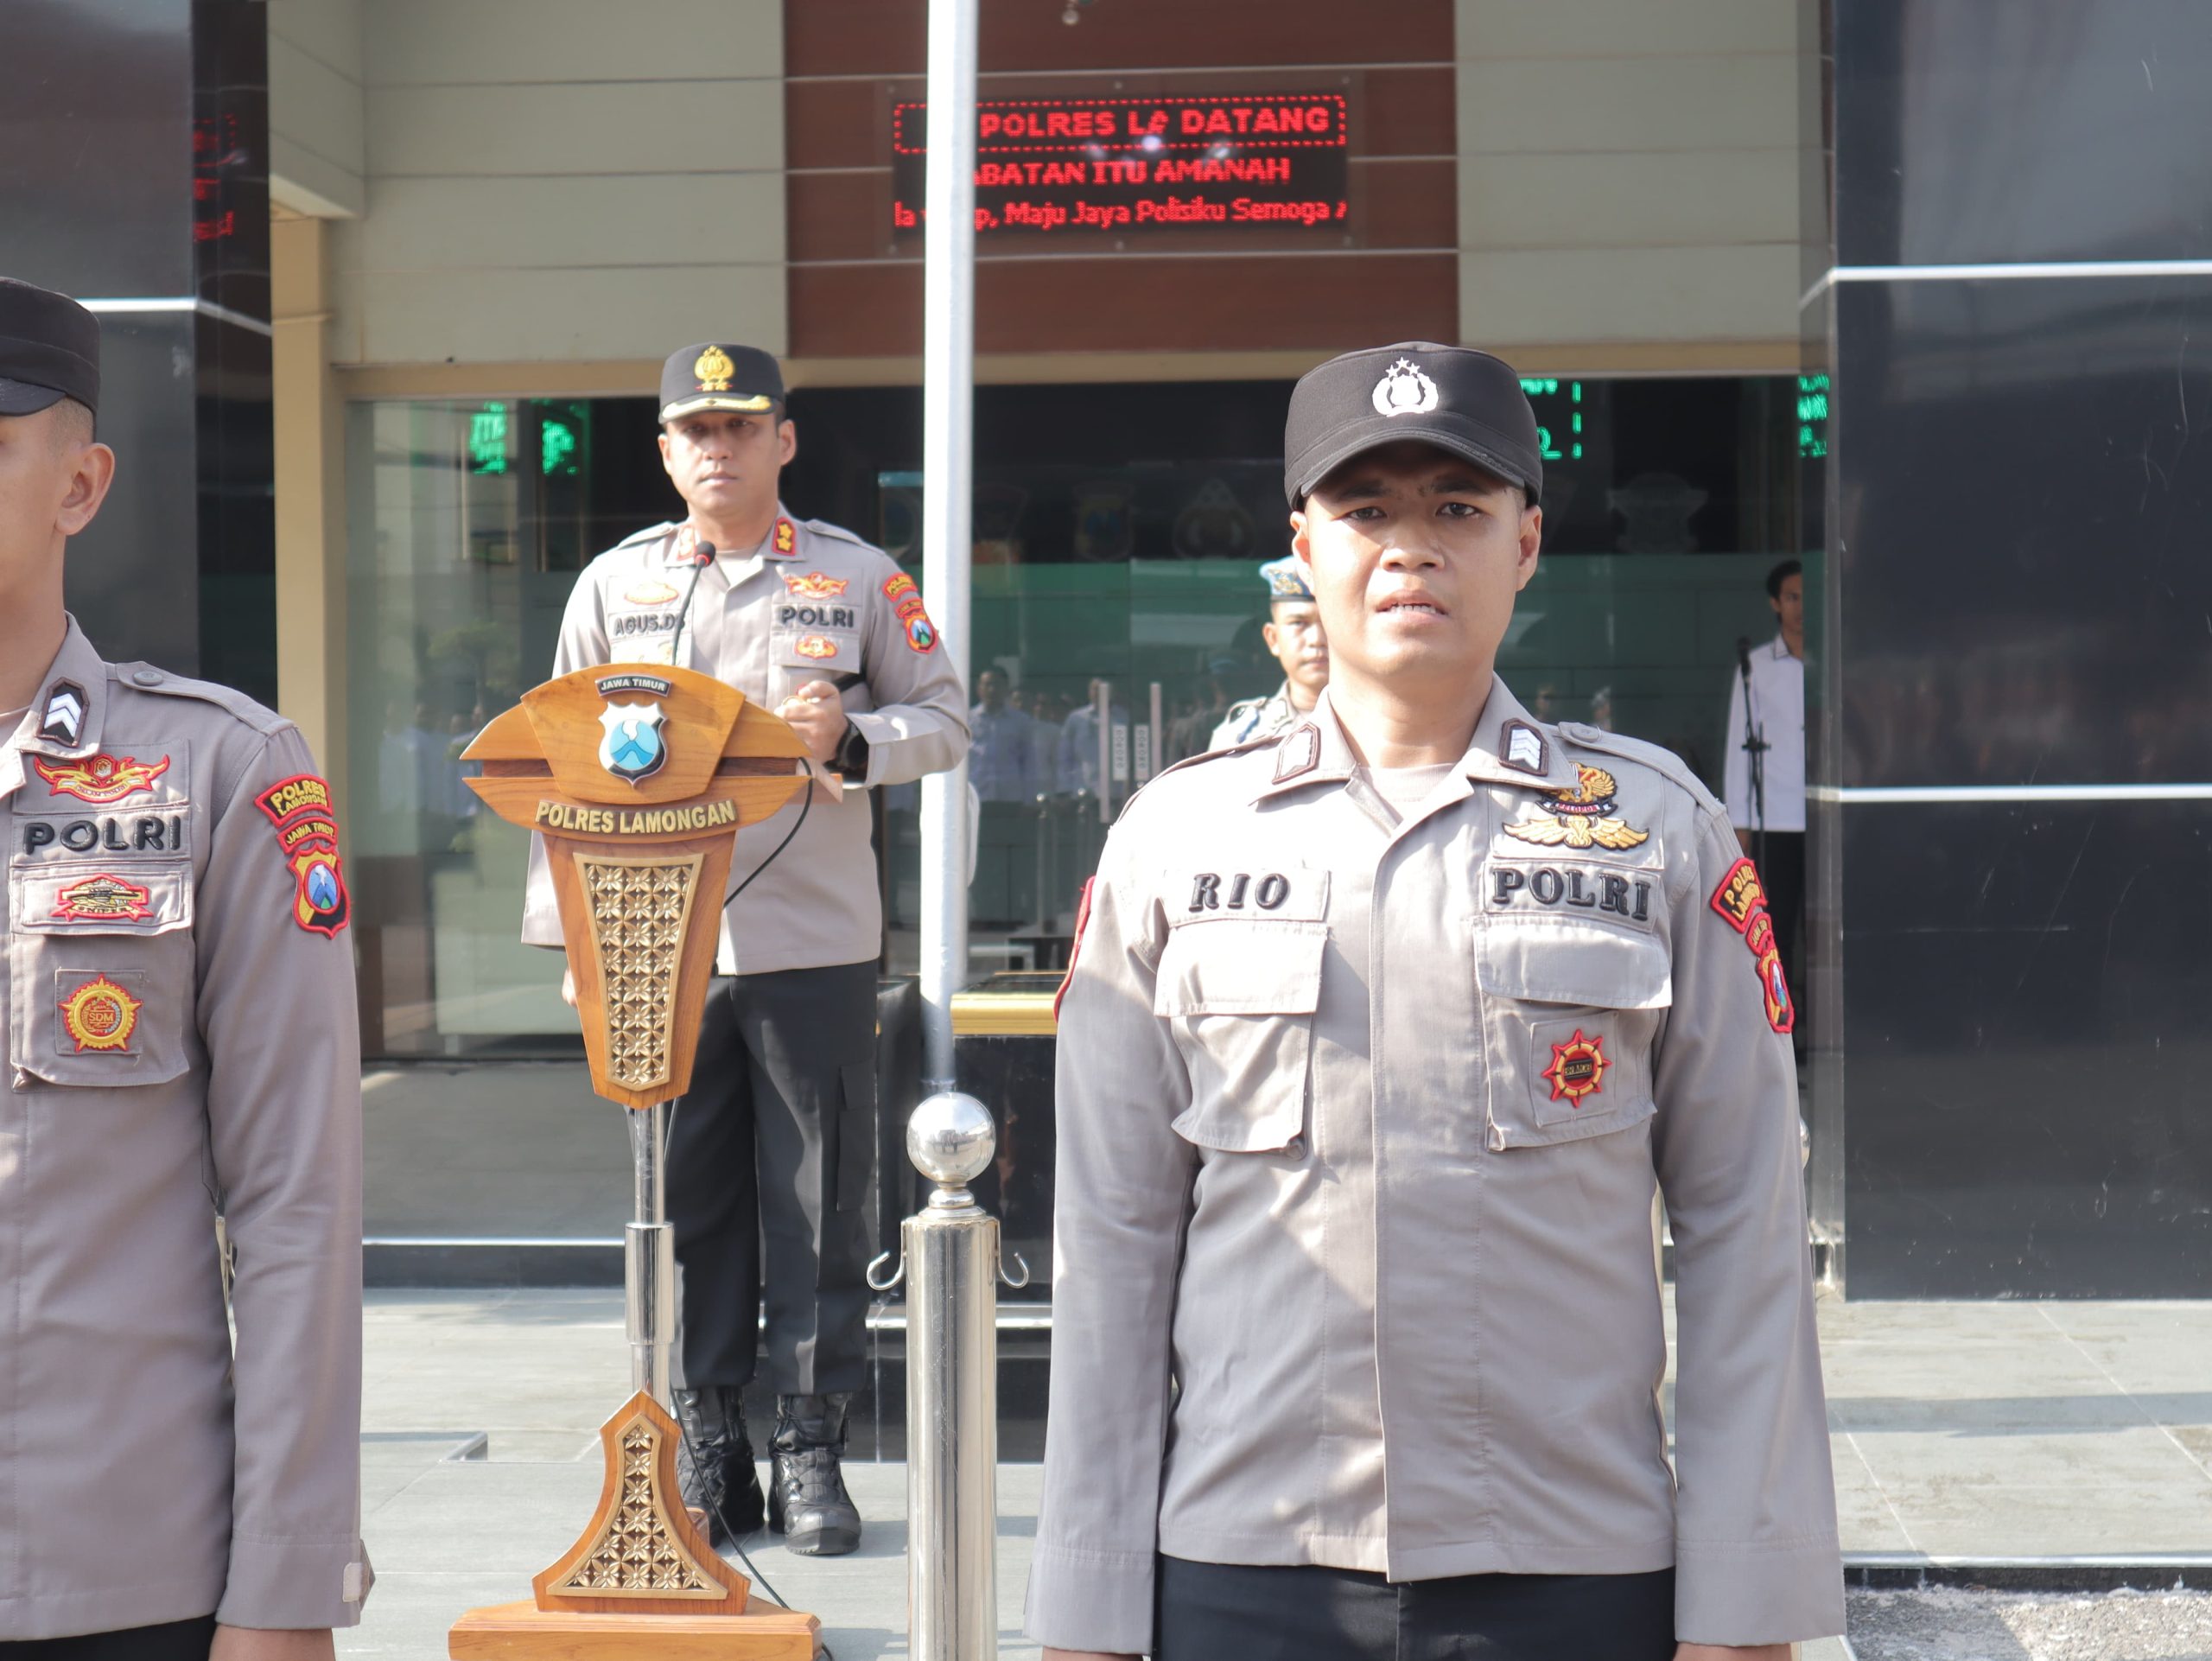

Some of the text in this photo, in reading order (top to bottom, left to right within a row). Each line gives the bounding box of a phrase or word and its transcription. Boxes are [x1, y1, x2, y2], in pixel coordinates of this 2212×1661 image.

[979, 111, 1116, 137] POLRES
[1180, 106, 1330, 134] DATANG
[974, 157, 1291, 188] BATAN ITU AMANAH
[1003, 201, 1067, 231] Maju
[1071, 200, 1131, 230] Jaya
[1230, 198, 1331, 226] Semoga
[781, 605, 855, 628] POLRI
[601, 678, 666, 692] JAWA TIMUR
[535, 799, 736, 835] POLRES LAMONGAN
[22, 815, 181, 856] POLRI
[1188, 873, 1291, 913] RIO
[1491, 867, 1652, 922] POLRI
[89, 1012, 114, 1022] SDM
